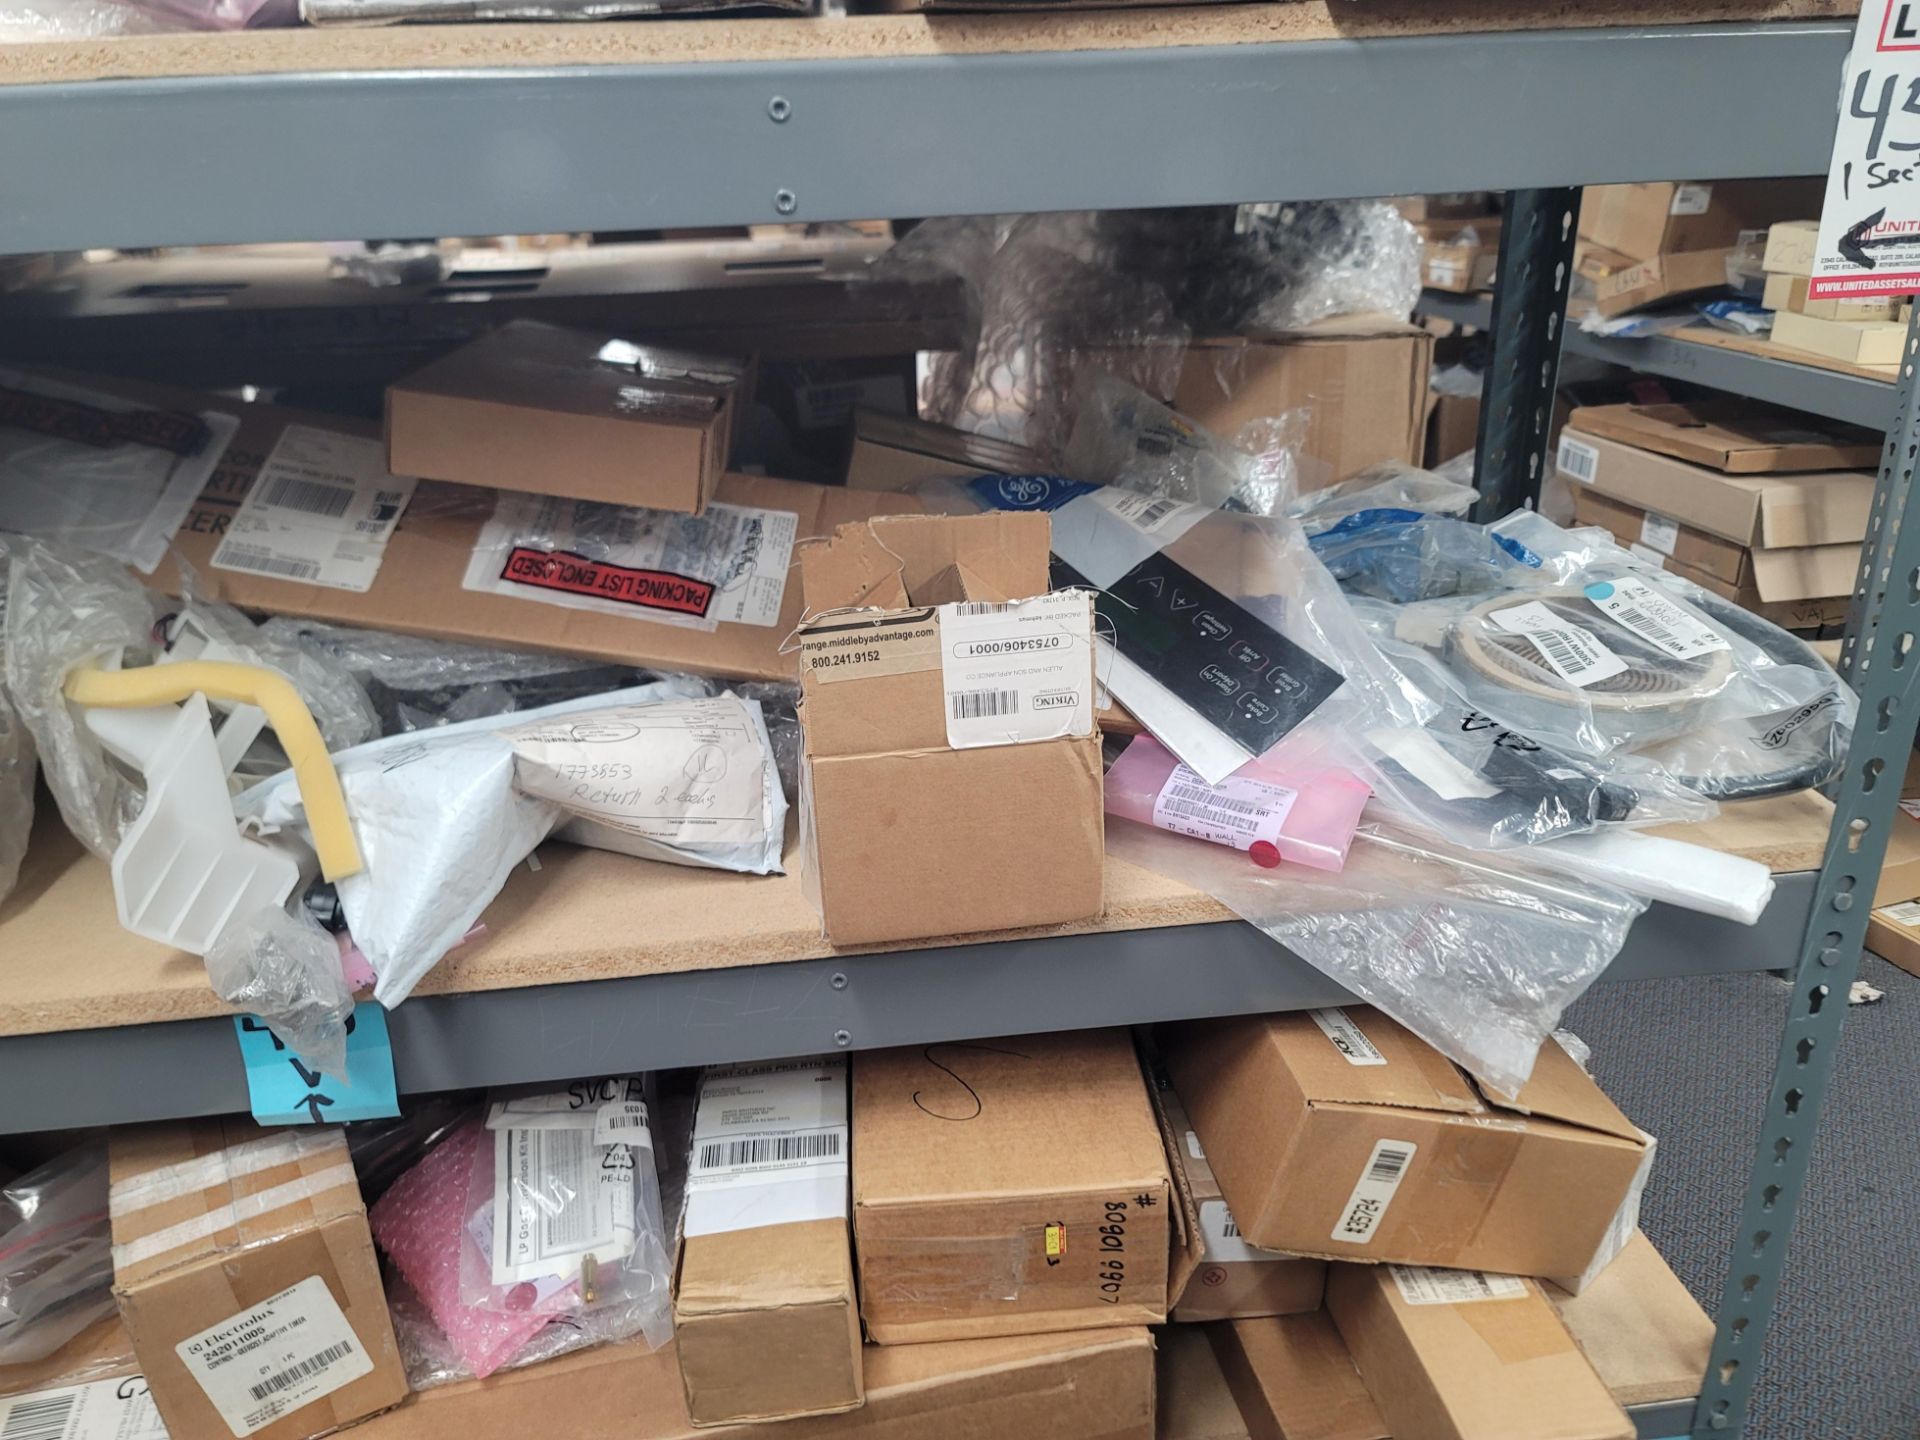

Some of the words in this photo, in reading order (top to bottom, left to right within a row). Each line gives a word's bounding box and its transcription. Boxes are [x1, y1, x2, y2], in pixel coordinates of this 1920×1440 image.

[1875, 220, 1920, 233] UNIT
[599, 575, 635, 597] LIST
[637, 579, 706, 608] PACKING
[969, 636, 1060, 656] 0753406/0001
[811, 650, 881, 669] 800.241.9152
[1035, 695, 1076, 707] VIKING
[570, 783, 641, 806] Return
[568, 1078, 618, 1110] SVC
[600, 1173, 632, 1184] PE-LD
[204, 1309, 275, 1347] Electrolux
[202, 1326, 266, 1361] 242011005
